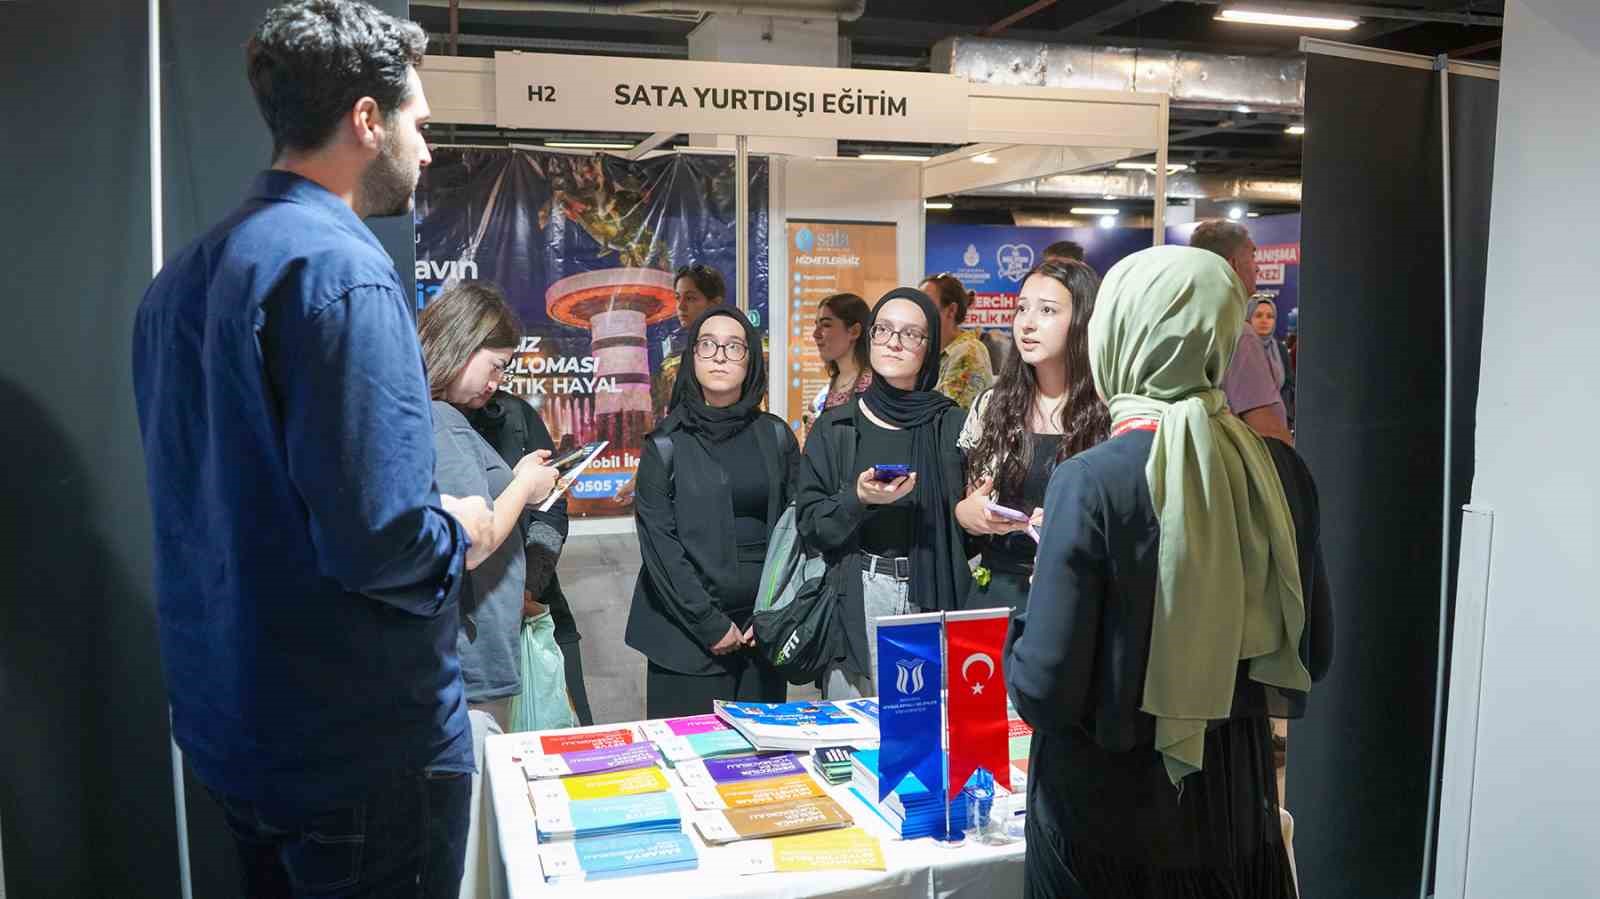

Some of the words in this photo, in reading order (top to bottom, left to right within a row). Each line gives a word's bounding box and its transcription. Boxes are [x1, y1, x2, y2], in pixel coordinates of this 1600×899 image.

[527, 85, 557, 103] H2
[614, 83, 688, 108] SATA
[692, 86, 815, 118] YURTDIŞI
[822, 87, 908, 117] EĞİTİM
[816, 228, 849, 247] sata
[415, 259, 479, 280] avın
[974, 293, 1013, 307] ERCİH
[964, 309, 999, 324] ERLİK
[513, 336, 542, 353] IZ
[499, 377, 548, 395] RTIK
[553, 376, 623, 394] HAYAL
[575, 480, 612, 492] 0505
